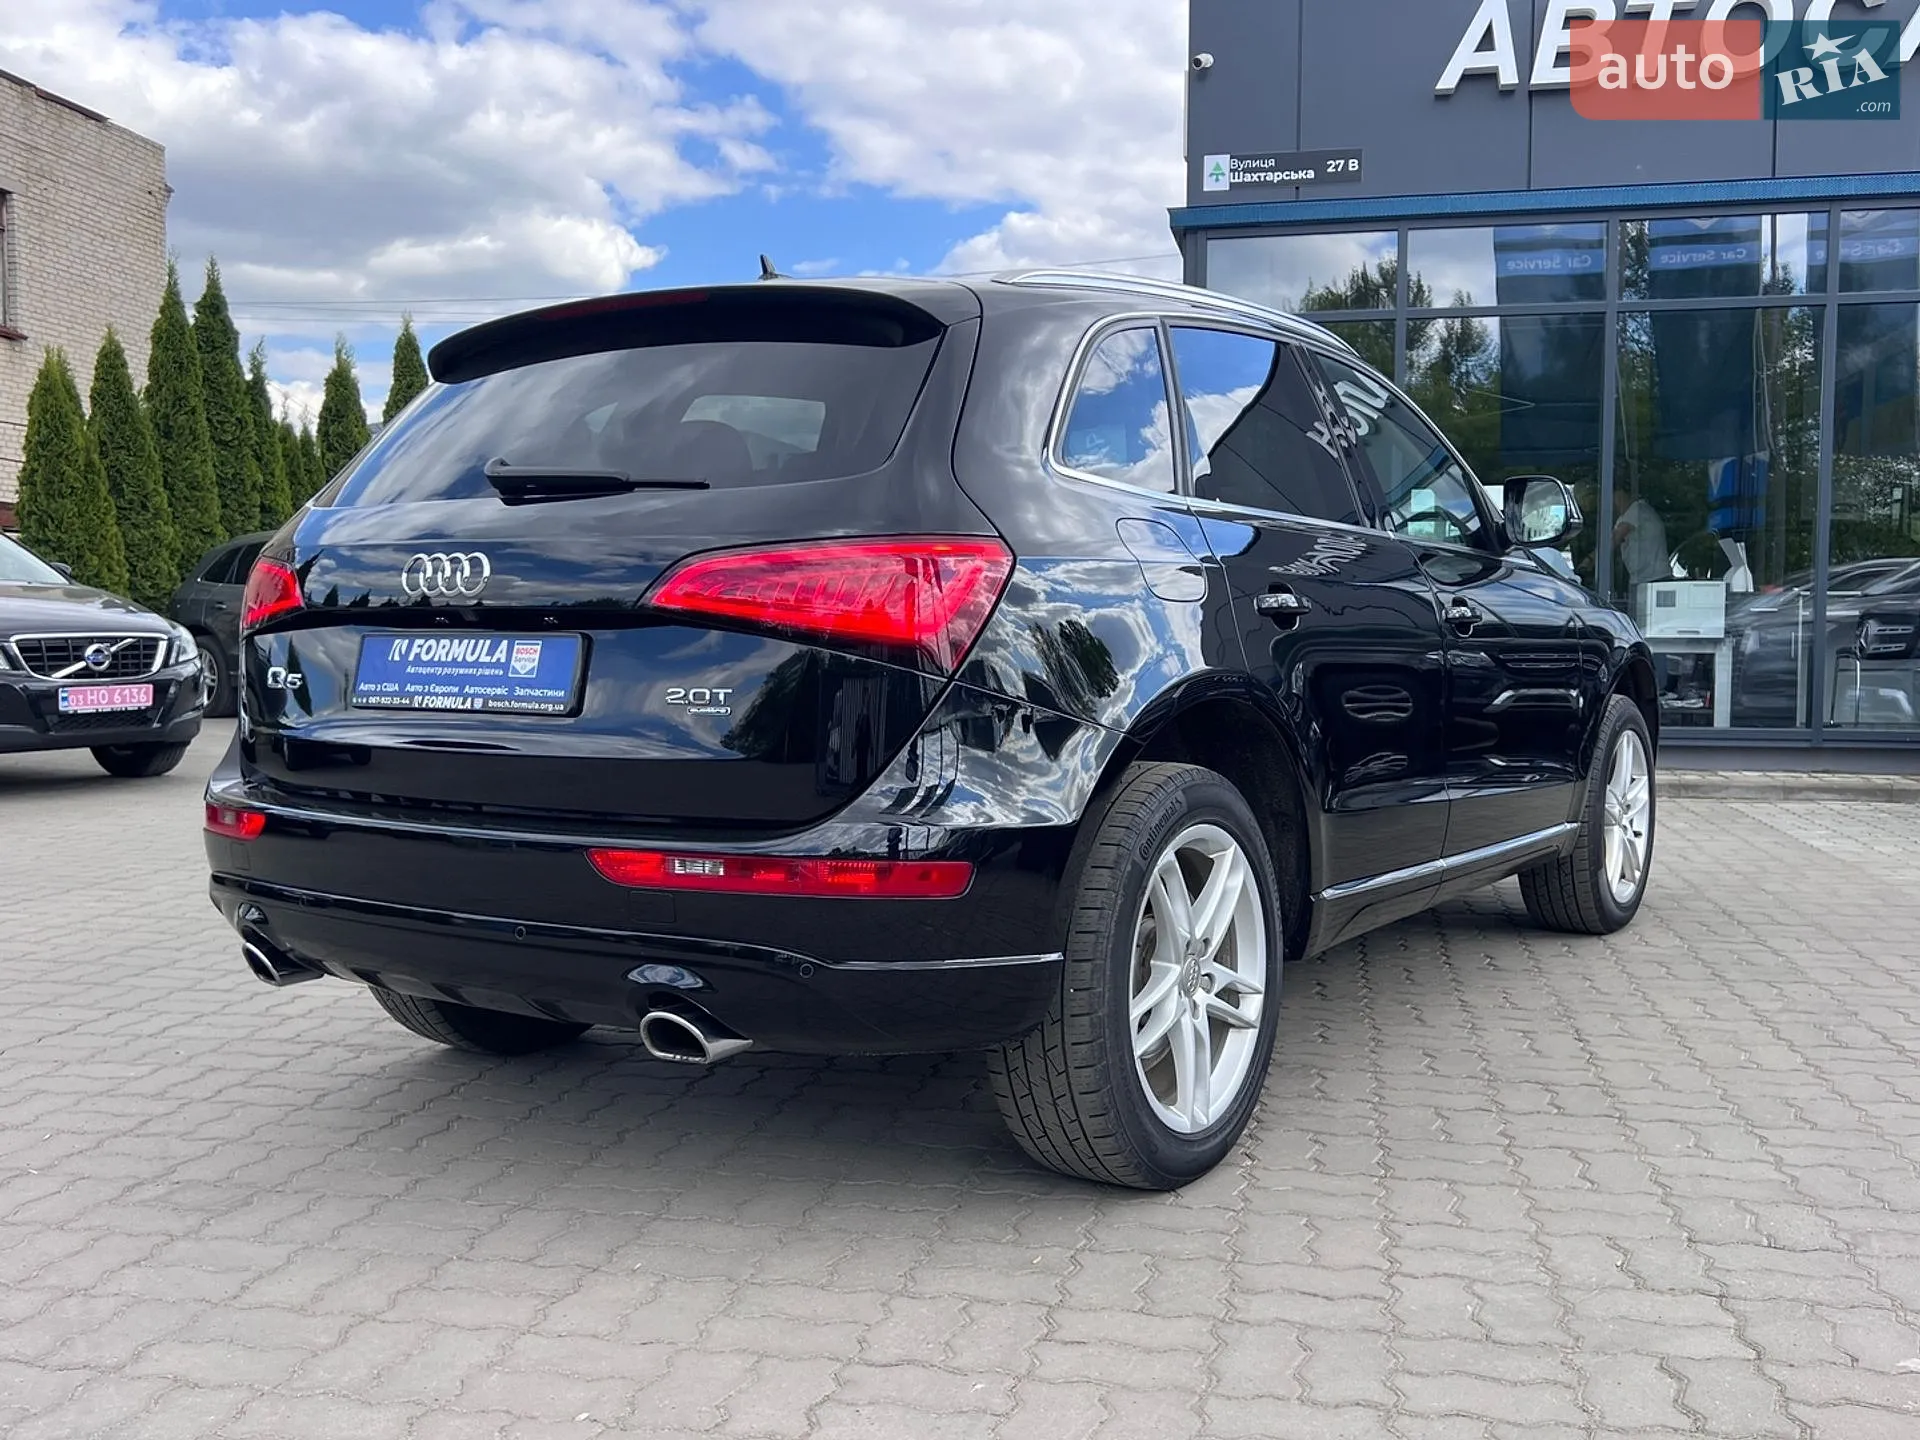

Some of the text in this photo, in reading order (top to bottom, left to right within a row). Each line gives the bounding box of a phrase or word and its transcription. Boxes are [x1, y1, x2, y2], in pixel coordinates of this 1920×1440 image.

[1434, 0, 1920, 95] АВТОС
[1230, 158, 1275, 171] Вулиця
[1230, 169, 1315, 183] Шахтарська
[1326, 159, 1345, 173] 27
[408, 638, 509, 663] FORMULA
[515, 646, 539, 656] BOSCH
[267, 666, 303, 689] Q5
[359, 682, 376, 692] Авто
[381, 682, 400, 692] США
[405, 683, 422, 693] Авто
[463, 684, 509, 696] Автосервіс
[513, 686, 565, 697] Запчастини
[68, 695, 84, 706] 03
[113, 687, 148, 704] 6136
[422, 696, 472, 709] FORMULA
[665, 687, 733, 705] 2.0T
[488, 699, 564, 711] bosch.formula.org.ua
